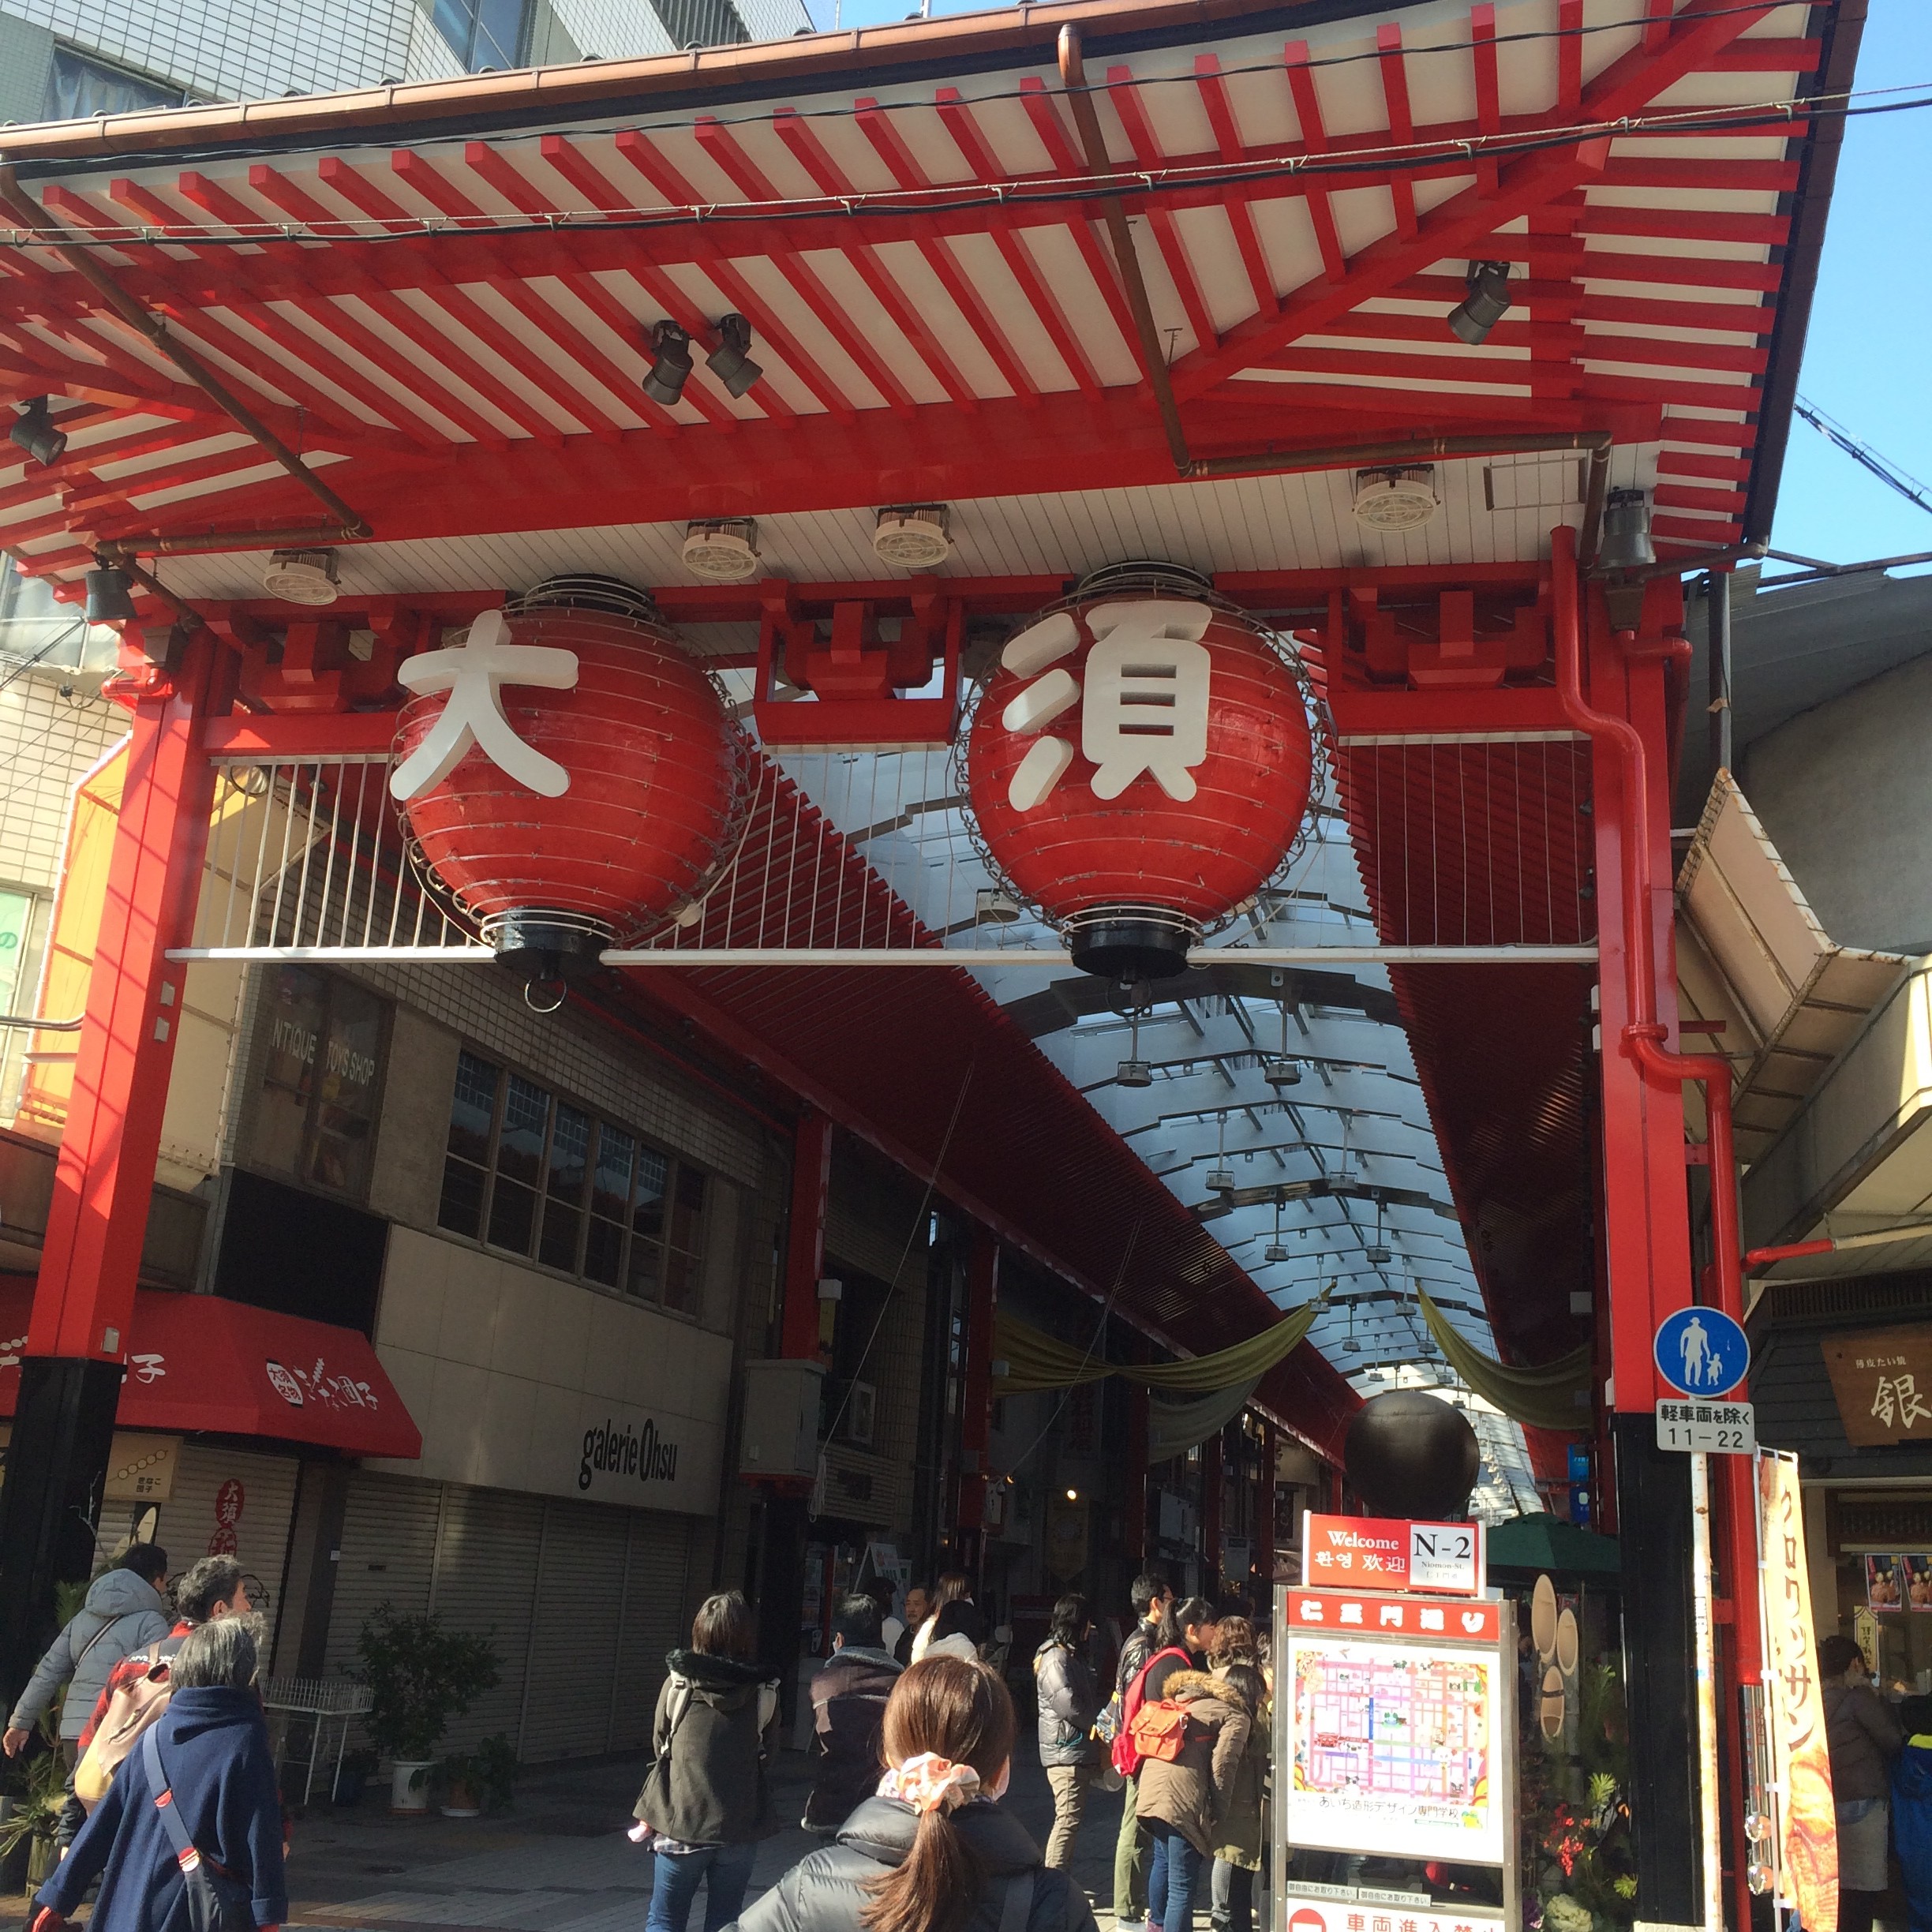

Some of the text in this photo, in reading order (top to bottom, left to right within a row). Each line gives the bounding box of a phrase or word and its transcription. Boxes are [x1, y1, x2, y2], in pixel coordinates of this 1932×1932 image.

[390, 600, 1214, 813] 大 須
[271, 1017, 375, 1086] NTIQUE TOYS SHOP
[1661, 1405, 1750, 1425] 軽車両を除く
[578, 1418, 678, 1491] galerie Ohsu
[136, 1485, 153, 1493] 団子
[137, 1477, 162, 1486] きなこ
[1327, 1530, 1399, 1550] Welcome
[1413, 1533, 1471, 1559] N-2
[1315, 1551, 1353, 1569] 환영
[1362, 1555, 1406, 1573] 欢迎
[1300, 1600, 1485, 1634] 仁王門通り
[1780, 1485, 1814, 1752] クロワッサン
[1346, 1913, 1500, 1932] 車両進入
